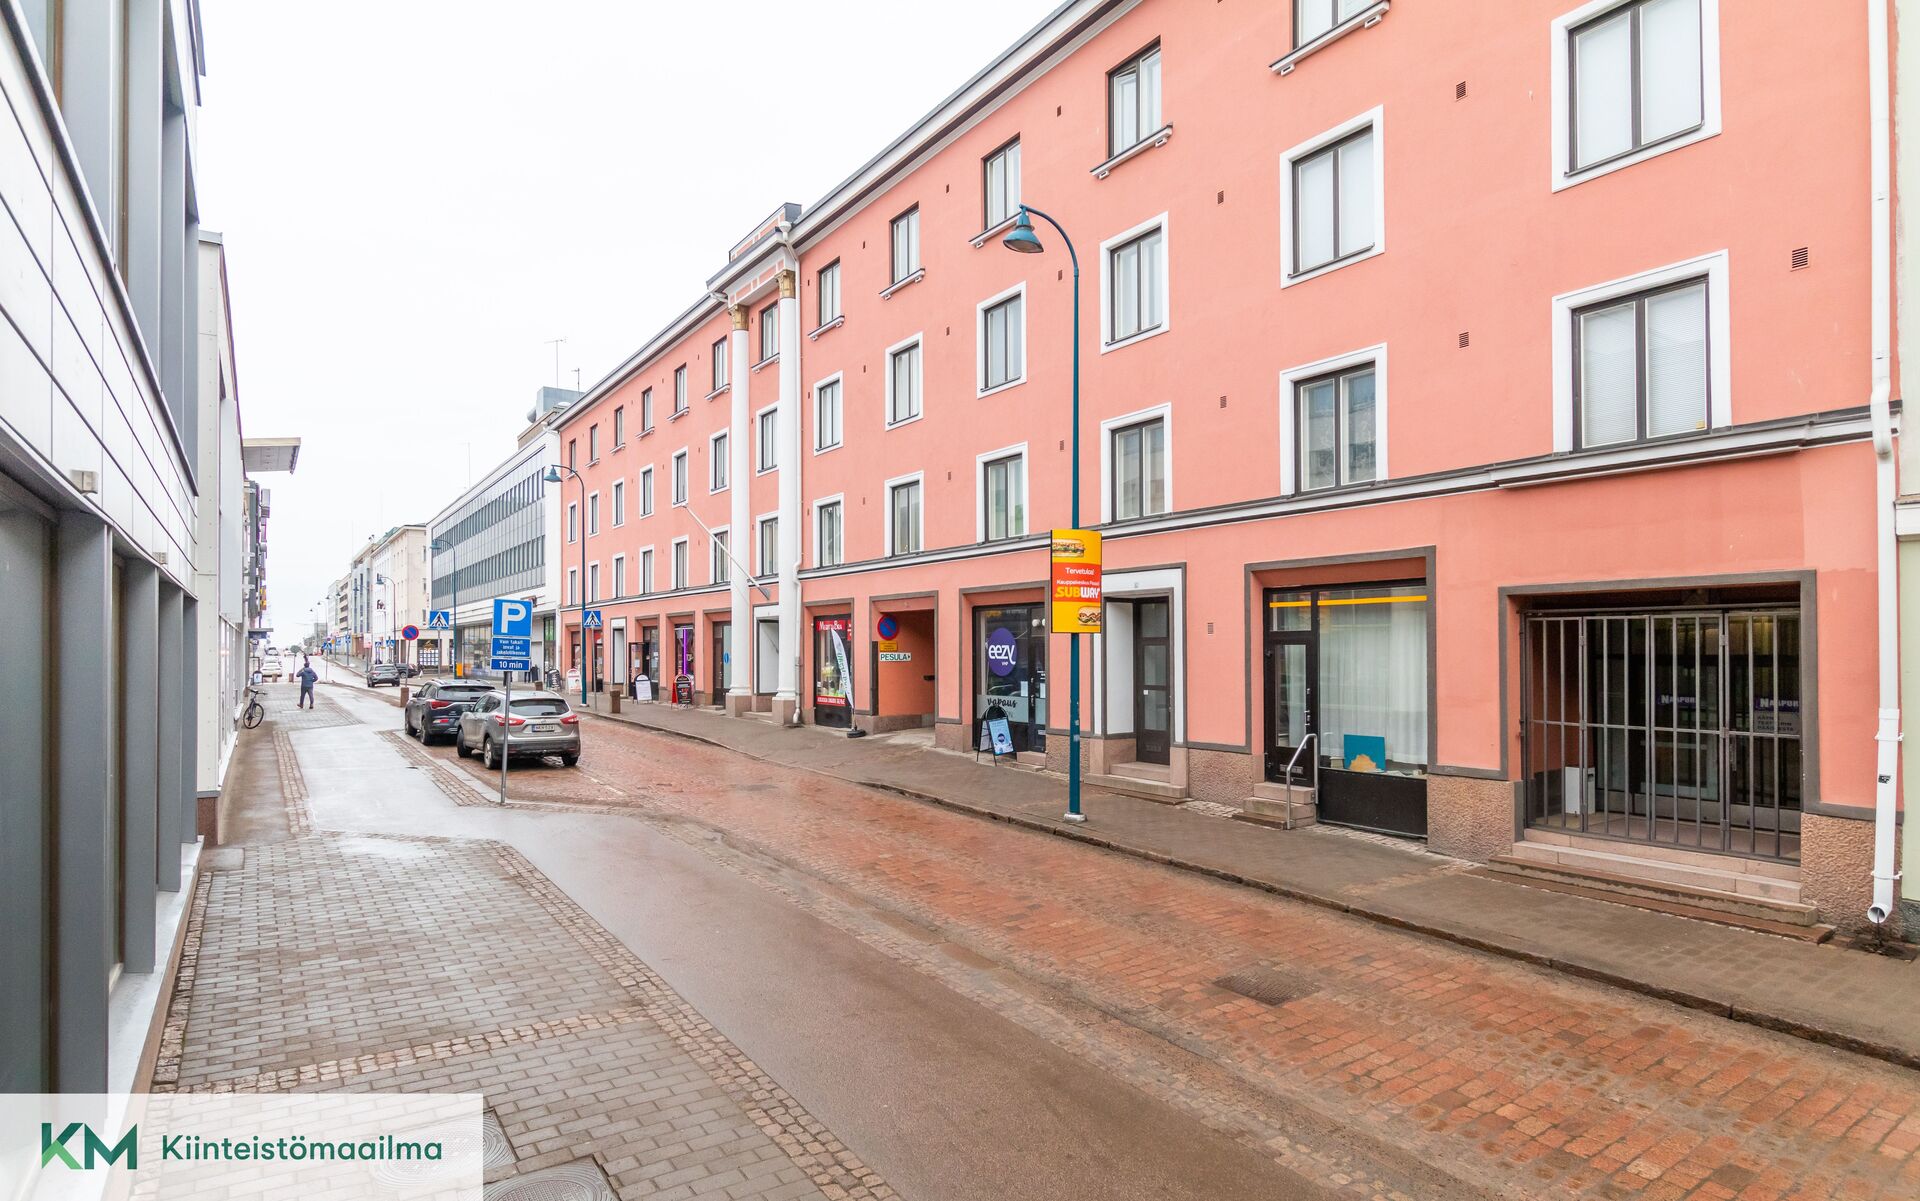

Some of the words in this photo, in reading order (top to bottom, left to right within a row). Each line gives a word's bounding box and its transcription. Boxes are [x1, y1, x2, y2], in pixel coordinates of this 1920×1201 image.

[1055, 586, 1101, 599] SUBWAY
[501, 602, 527, 634] P
[880, 653, 907, 661] PESULA
[988, 645, 1016, 665] eezy
[499, 661, 508, 669] 10
[509, 661, 523, 669] min
